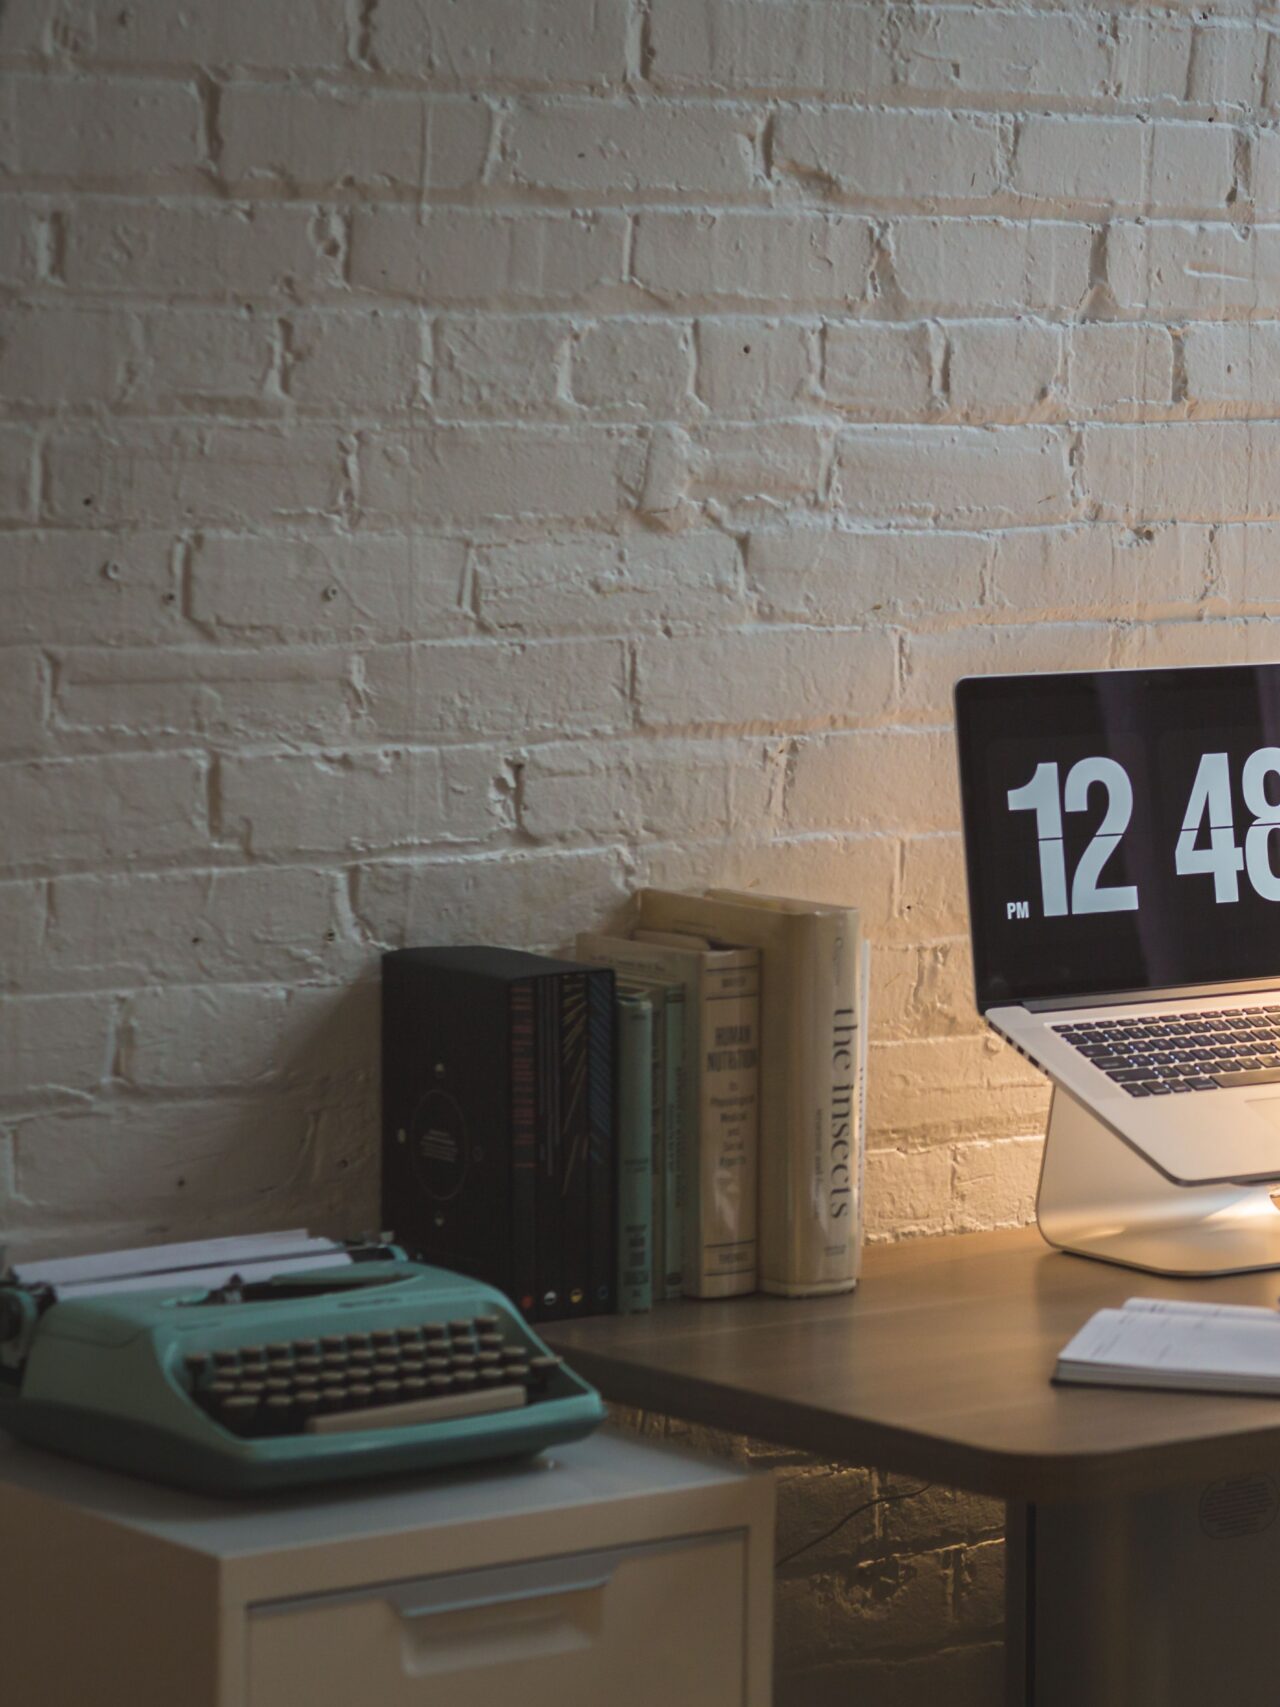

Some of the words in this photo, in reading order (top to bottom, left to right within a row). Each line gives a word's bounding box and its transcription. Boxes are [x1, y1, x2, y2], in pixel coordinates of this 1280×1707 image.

[1006, 757, 1139, 917] 12
[1006, 901, 1030, 920] PM
[832, 1008, 858, 1071] the
[830, 1084, 854, 1219] insects
